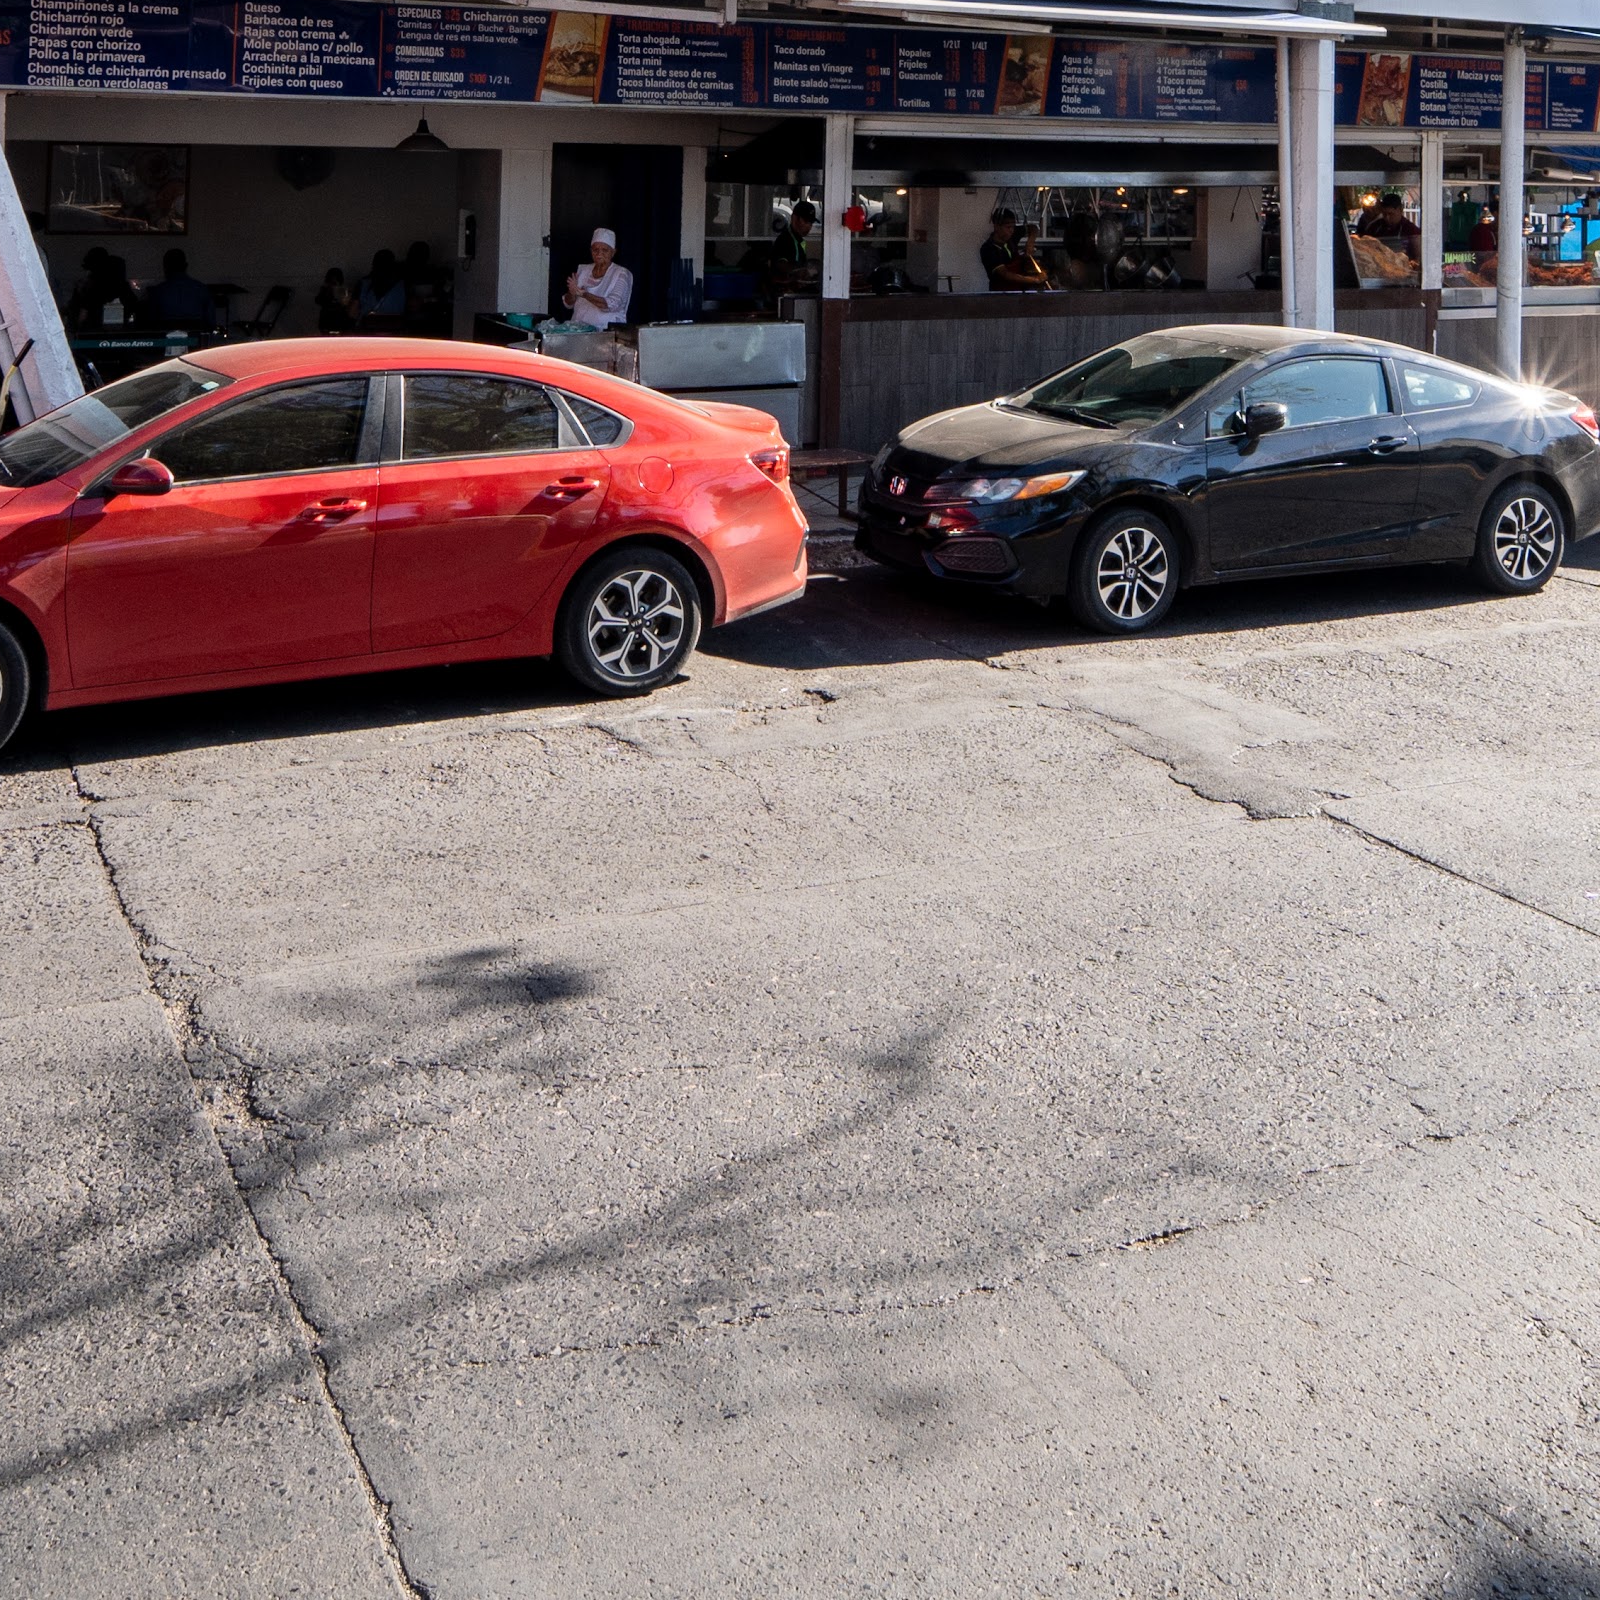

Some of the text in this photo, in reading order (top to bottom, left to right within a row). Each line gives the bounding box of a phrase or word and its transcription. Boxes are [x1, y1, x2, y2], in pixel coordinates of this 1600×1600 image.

[128, 2, 139, 13] la
[142, 5, 179, 15] crema
[245, 1, 281, 14] Queso
[30, 11, 124, 27] Chicharrón rojo
[244, 14, 334, 28] Barbacoa de res
[397, 7, 547, 24] ESPECIALES Chicharrón seco
[29, 23, 133, 38] Chicharrón verde
[244, 26, 336, 40] Rajas con crema
[397, 20, 504, 33] Carnitas Lengua Buche
[29, 36, 141, 51] Papas con chorizo
[243, 39, 363, 54] Mole poblano pollo
[472, 35, 518, 44] salsa verde
[618, 33, 680, 46] Torta ahogada
[28, 48, 145, 64] Pollo la primavera
[395, 45, 444, 57] COMBINADAS
[642, 45, 690, 56] combinada
[242, 50, 375, 66] Arrachera la mexicana
[27, 62, 226, 81] Chonchis de chicharrón prensado
[242, 63, 323, 77] Cochinita pibil
[617, 66, 654, 77] Tamales
[774, 61, 853, 75] Manitas Vinagre
[27, 75, 168, 90] Costilla con verdolagas
[242, 75, 343, 90] Frijoles con queso
[395, 70, 464, 83] ORDEN DE GUISADO
[617, 77, 734, 90] Tacos blanditos carnitas
[412, 89, 497, 99] carne vegetarianos
[617, 89, 709, 100] Chamorros adobados
[1061, 104, 1101, 115] Chocomilk
